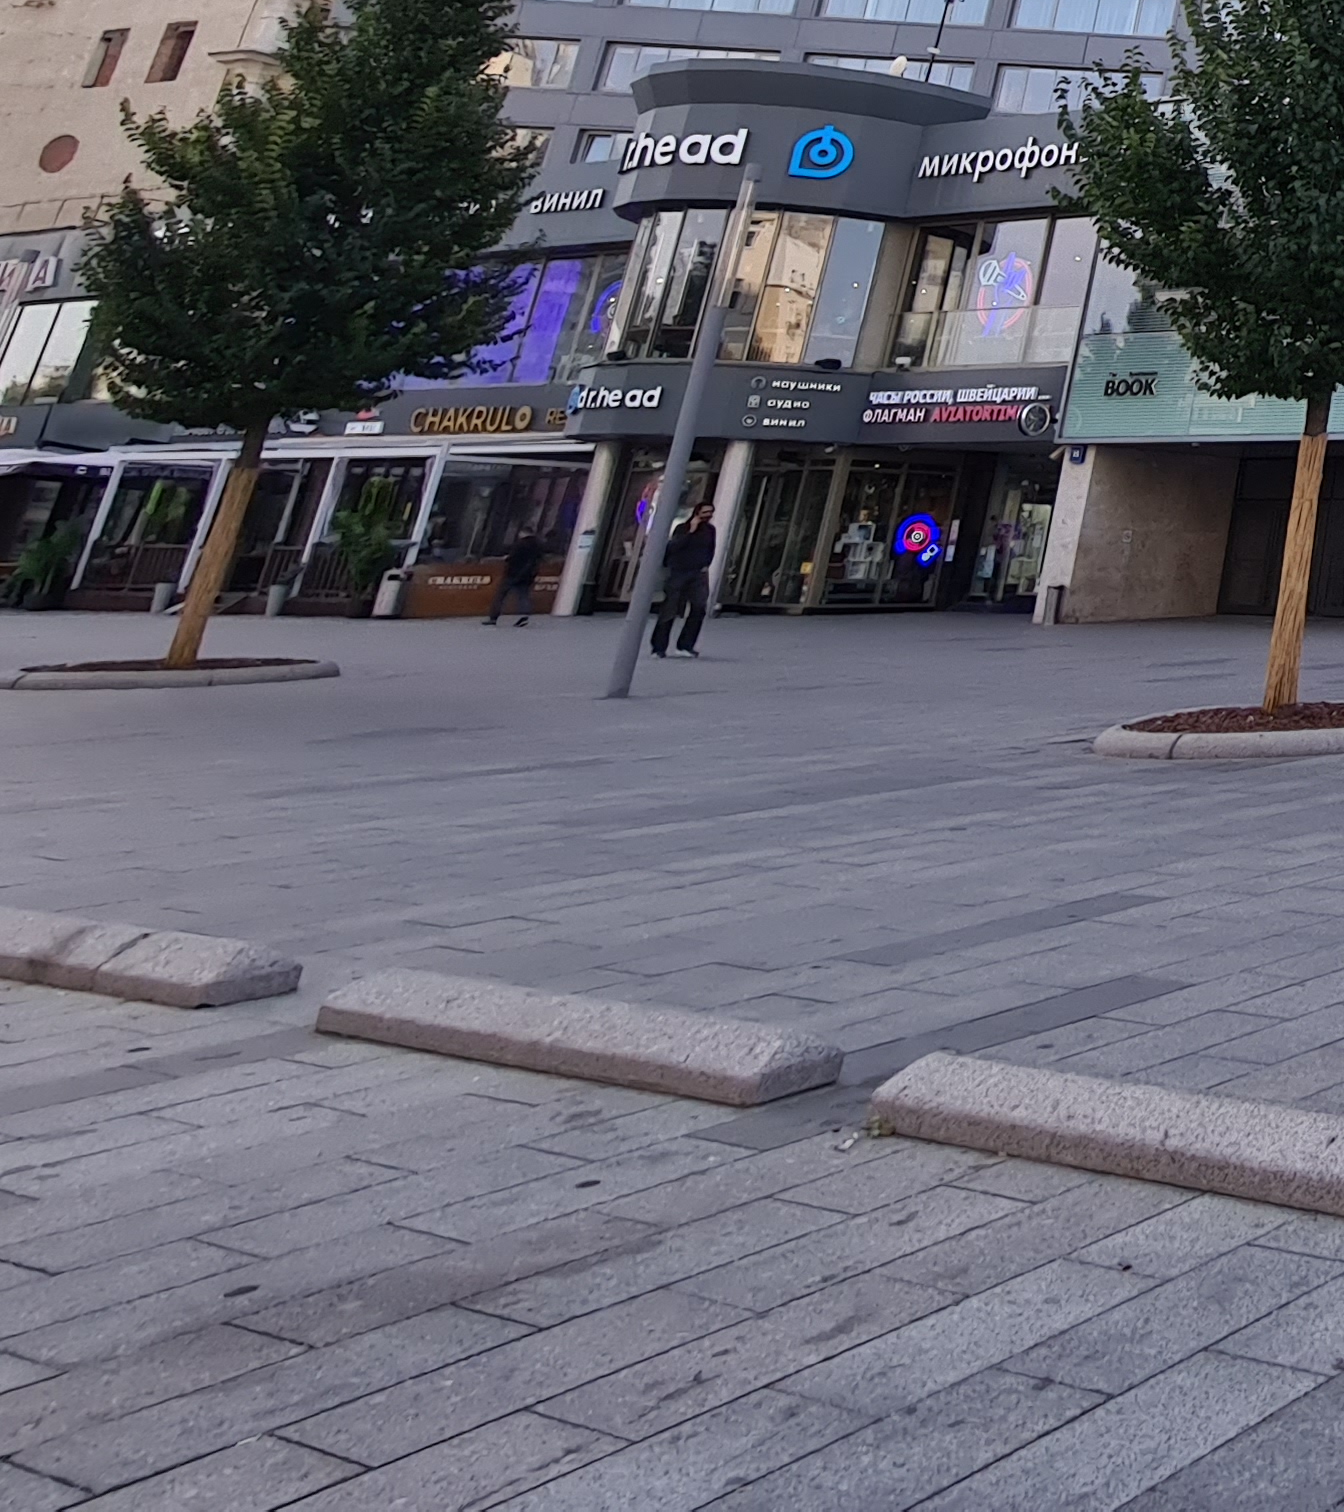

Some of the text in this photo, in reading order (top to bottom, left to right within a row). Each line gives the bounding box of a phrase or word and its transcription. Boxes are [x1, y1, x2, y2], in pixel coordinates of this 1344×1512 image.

[918, 137, 1089, 183] микрофон
[771, 379, 842, 392] наушники
[1104, 378, 1157, 397] BOOK
[578, 386, 662, 410] dr.head
[766, 398, 811, 409] аудио
[869, 390, 902, 405] ЧАСЫ
[410, 405, 533, 433] CHAKRULO
[762, 417, 806, 427] винил
[863, 405, 1022, 424] ФЛАГМАН AVIATORTIM
